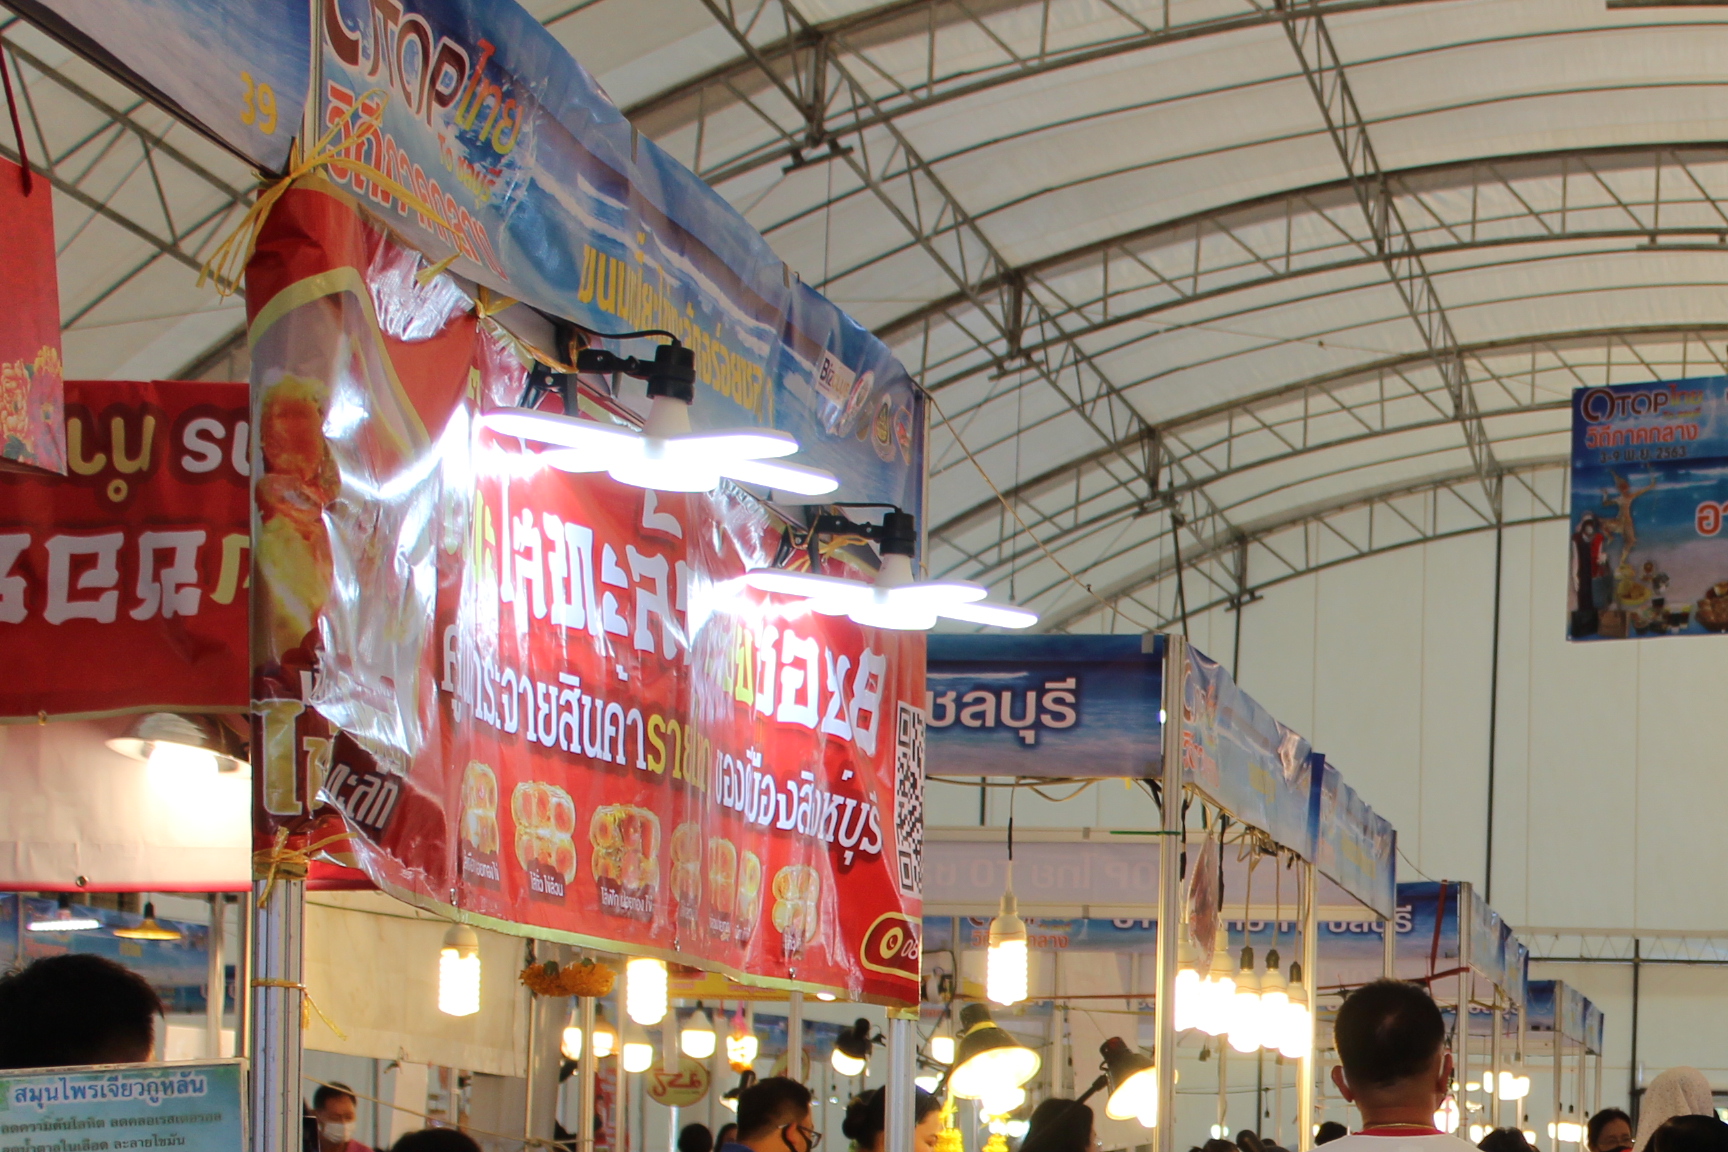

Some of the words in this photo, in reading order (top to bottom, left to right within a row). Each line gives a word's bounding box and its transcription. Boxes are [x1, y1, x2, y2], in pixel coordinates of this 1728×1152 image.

[239, 70, 277, 136] 39
[1580, 388, 1669, 424] OTOP
[926, 677, 1077, 744] ชลบุรี
[114, 1133, 185, 1150] ละลายไขมัน
